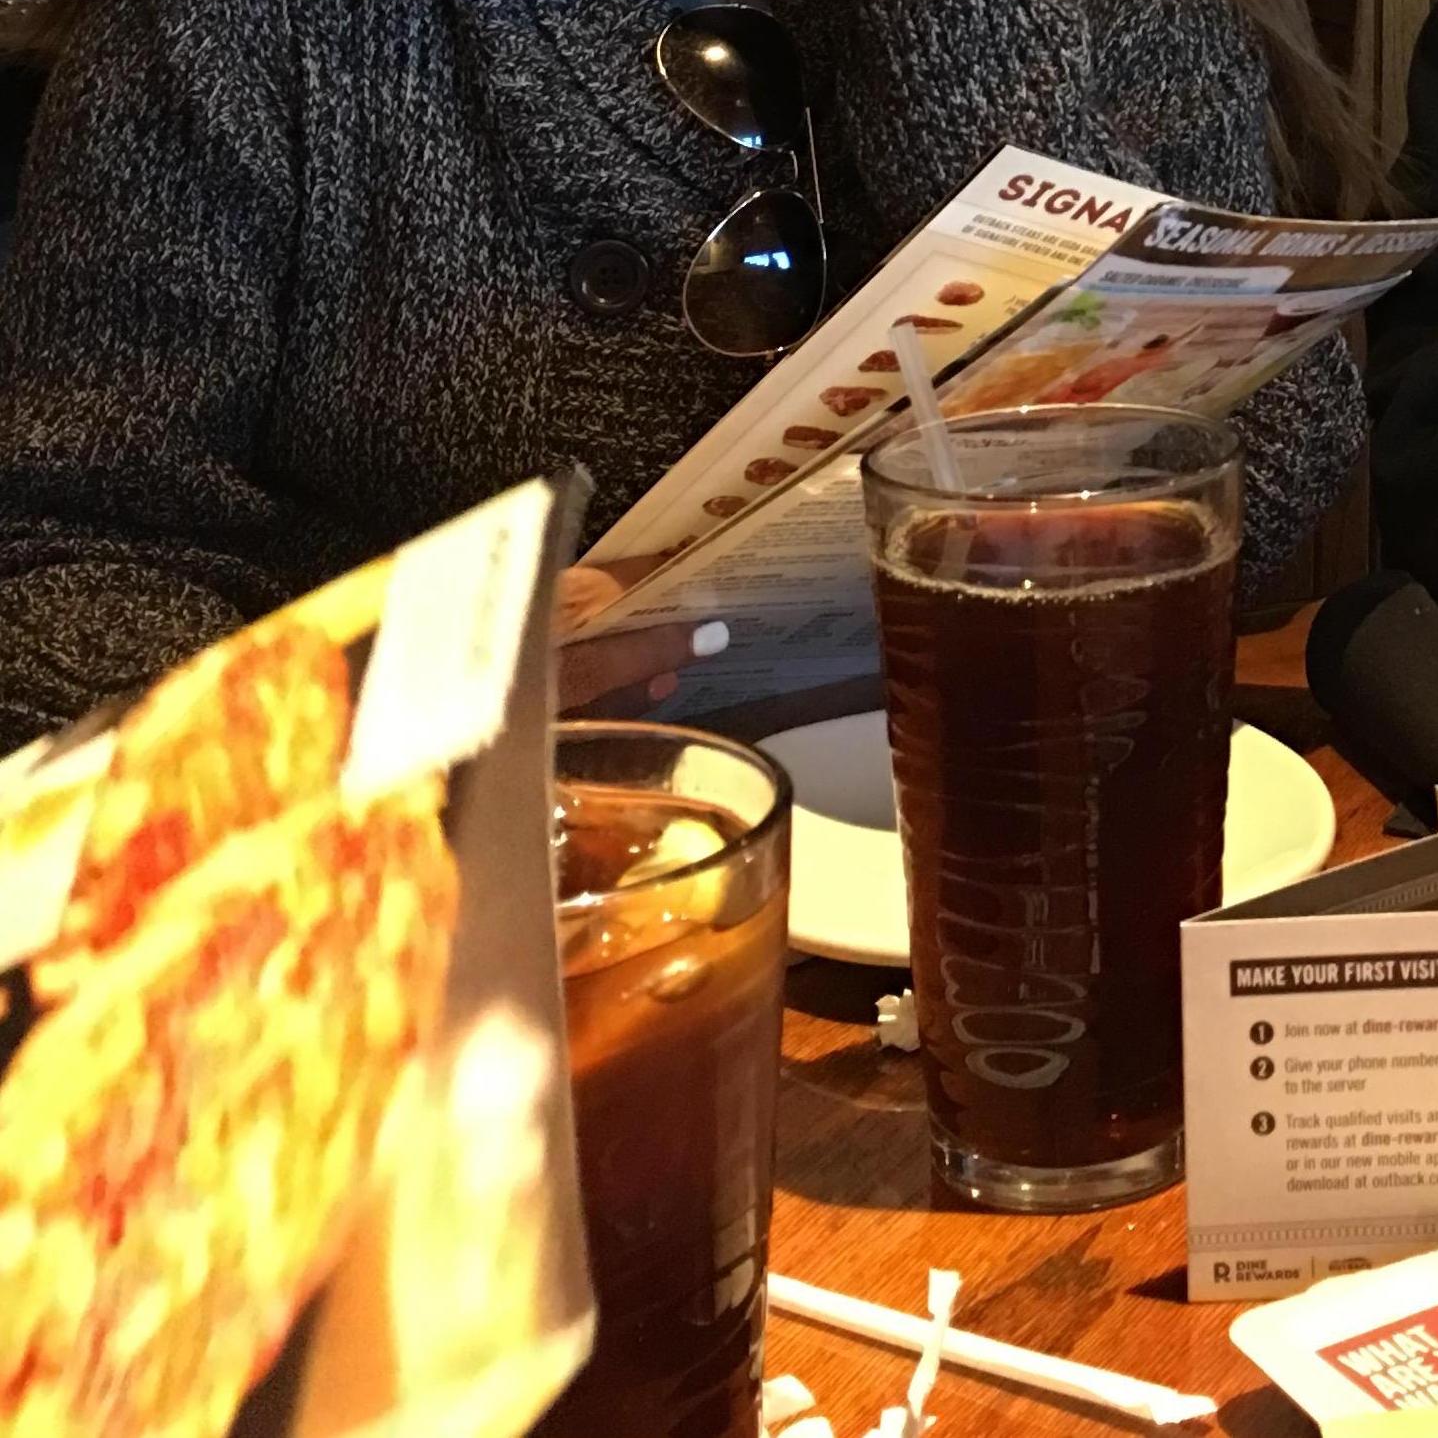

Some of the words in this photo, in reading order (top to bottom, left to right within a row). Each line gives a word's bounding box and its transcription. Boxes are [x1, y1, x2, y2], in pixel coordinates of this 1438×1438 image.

[999, 175, 1133, 233] SIGNA
[1237, 966, 1285, 988] MAKE
[1291, 964, 1338, 984] YOUR
[1345, 962, 1394, 982] FIRST
[1285, 1023, 1309, 1038] Join
[1314, 1023, 1342, 1036] now
[1346, 1021, 1357, 1035] at
[1285, 1059, 1313, 1073] Give
[1317, 1060, 1343, 1074] your
[1349, 1057, 1386, 1077] phone
[1285, 1081, 1297, 1095] to
[1302, 1080, 1322, 1093] the
[1327, 1078, 1366, 1091] server
[1287, 1114, 1320, 1129] Track
[1326, 1111, 1382, 1133] qualified
[1386, 1112, 1421, 1125] visits
[1286, 1134, 1338, 1151] rewards
[1343, 1134, 1356, 1147] at
[1286, 1159, 1298, 1171] or
[1304, 1154, 1315, 1170] in
[1321, 1157, 1342, 1169] our
[1346, 1154, 1372, 1167] new
[1377, 1151, 1420, 1165] mobile
[1288, 1178, 1349, 1192] download
[1355, 1176, 1367, 1189] at
[1236, 1260, 1267, 1270] DINE
[1236, 1270, 1299, 1282] REWARDS
